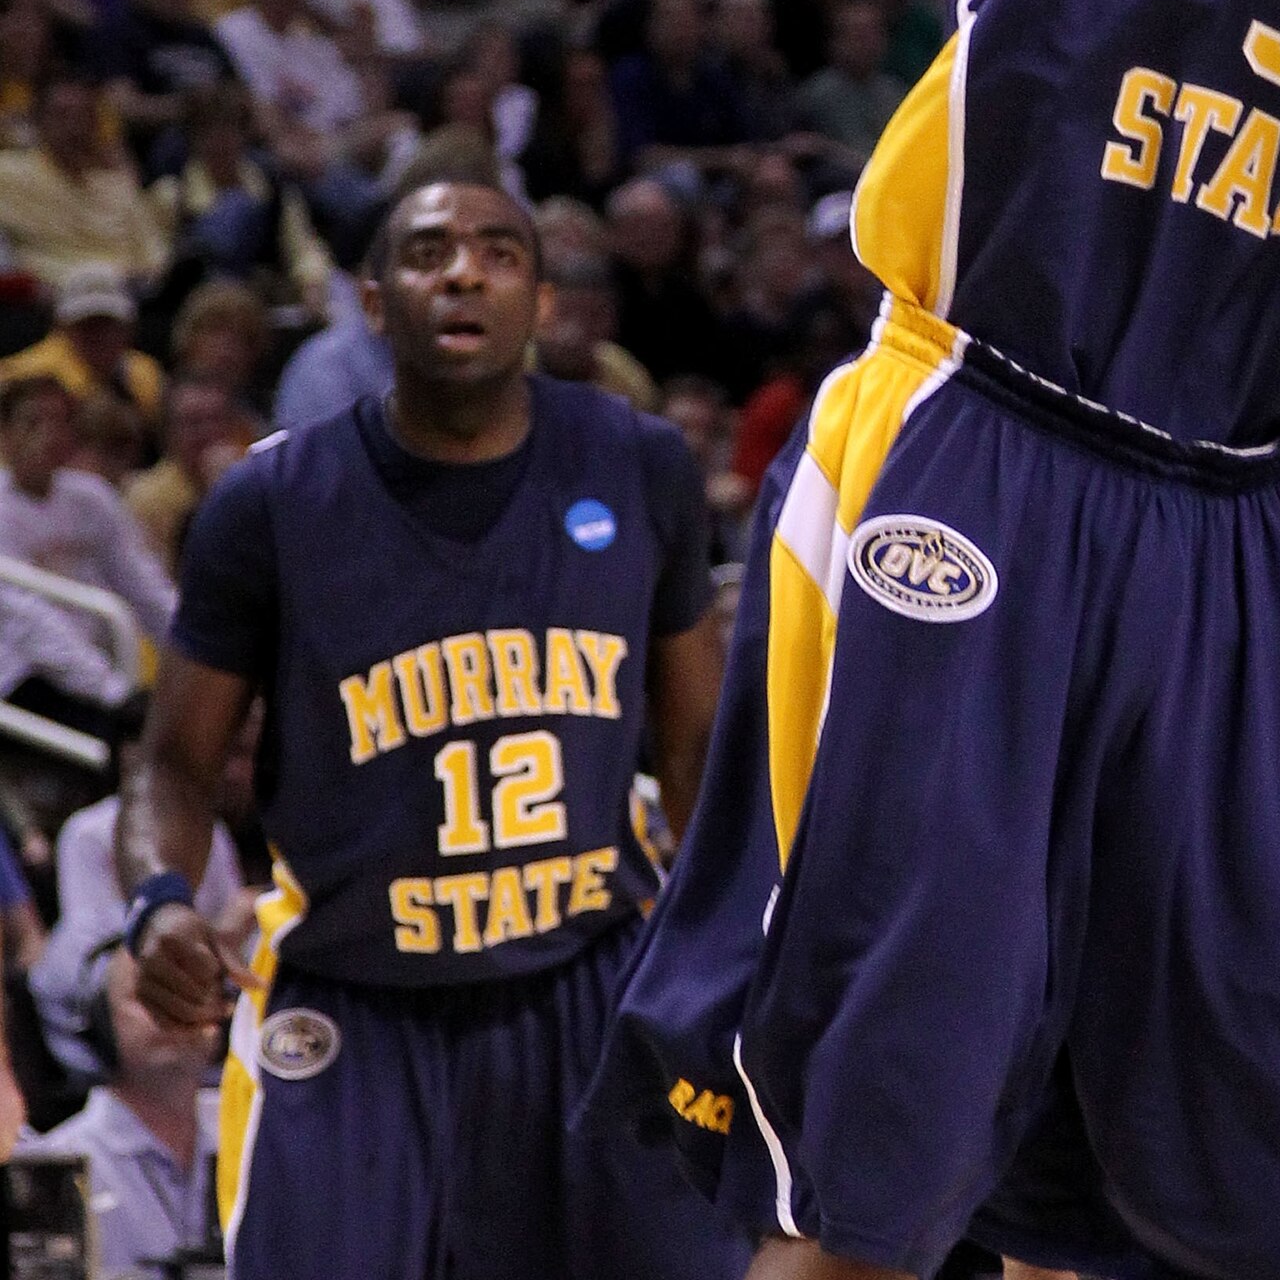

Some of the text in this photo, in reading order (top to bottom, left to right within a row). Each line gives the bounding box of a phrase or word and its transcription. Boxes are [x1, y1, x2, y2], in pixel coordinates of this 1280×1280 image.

[880, 542, 962, 595] OVC
[339, 627, 628, 766] MURRAY
[435, 729, 568, 857] 12
[389, 846, 618, 955] STATE
